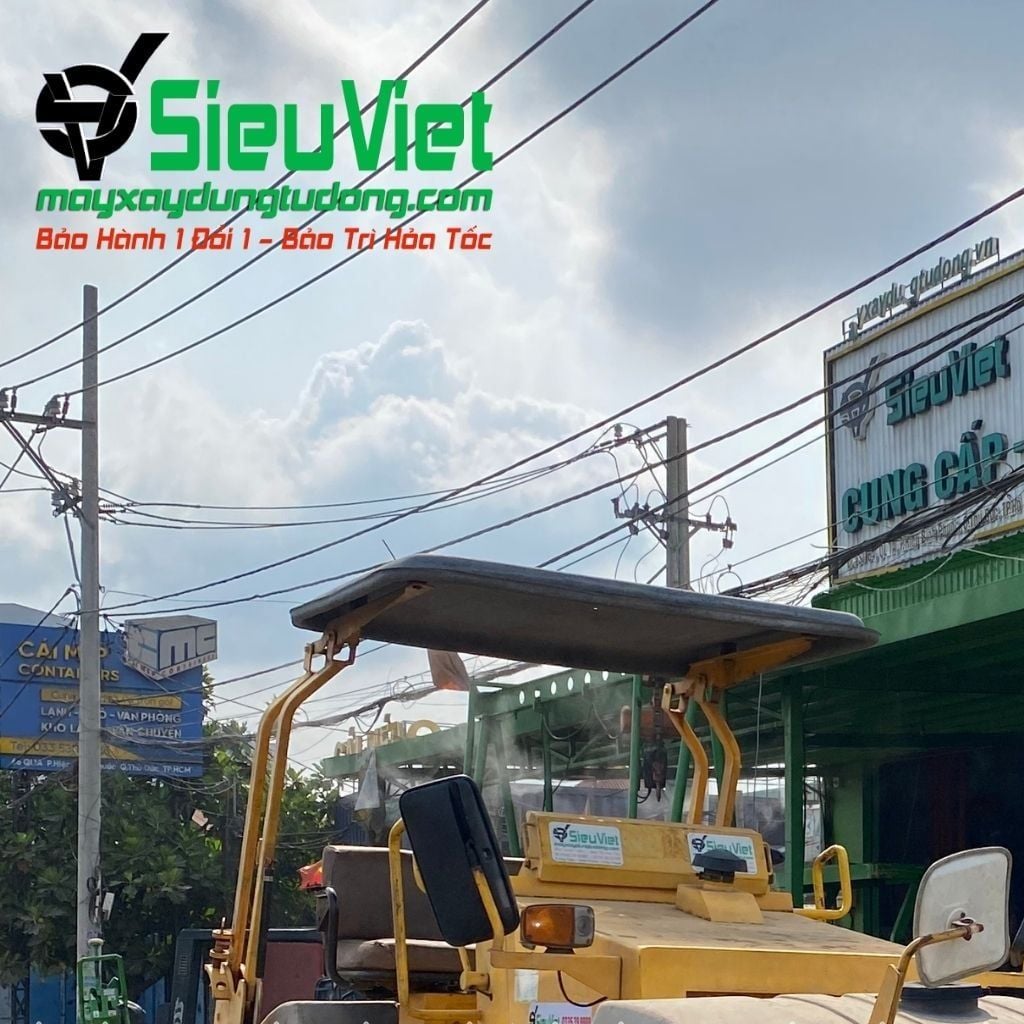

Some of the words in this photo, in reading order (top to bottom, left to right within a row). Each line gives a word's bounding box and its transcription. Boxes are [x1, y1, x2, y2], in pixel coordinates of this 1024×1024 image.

[885, 335, 1010, 425] SieuViet
[841, 463, 927, 533] CUNG
[934, 420, 1008, 501] CẤP
[18, 663, 120, 682] CONTAIRS
[569, 829, 620, 846] SieuViet
